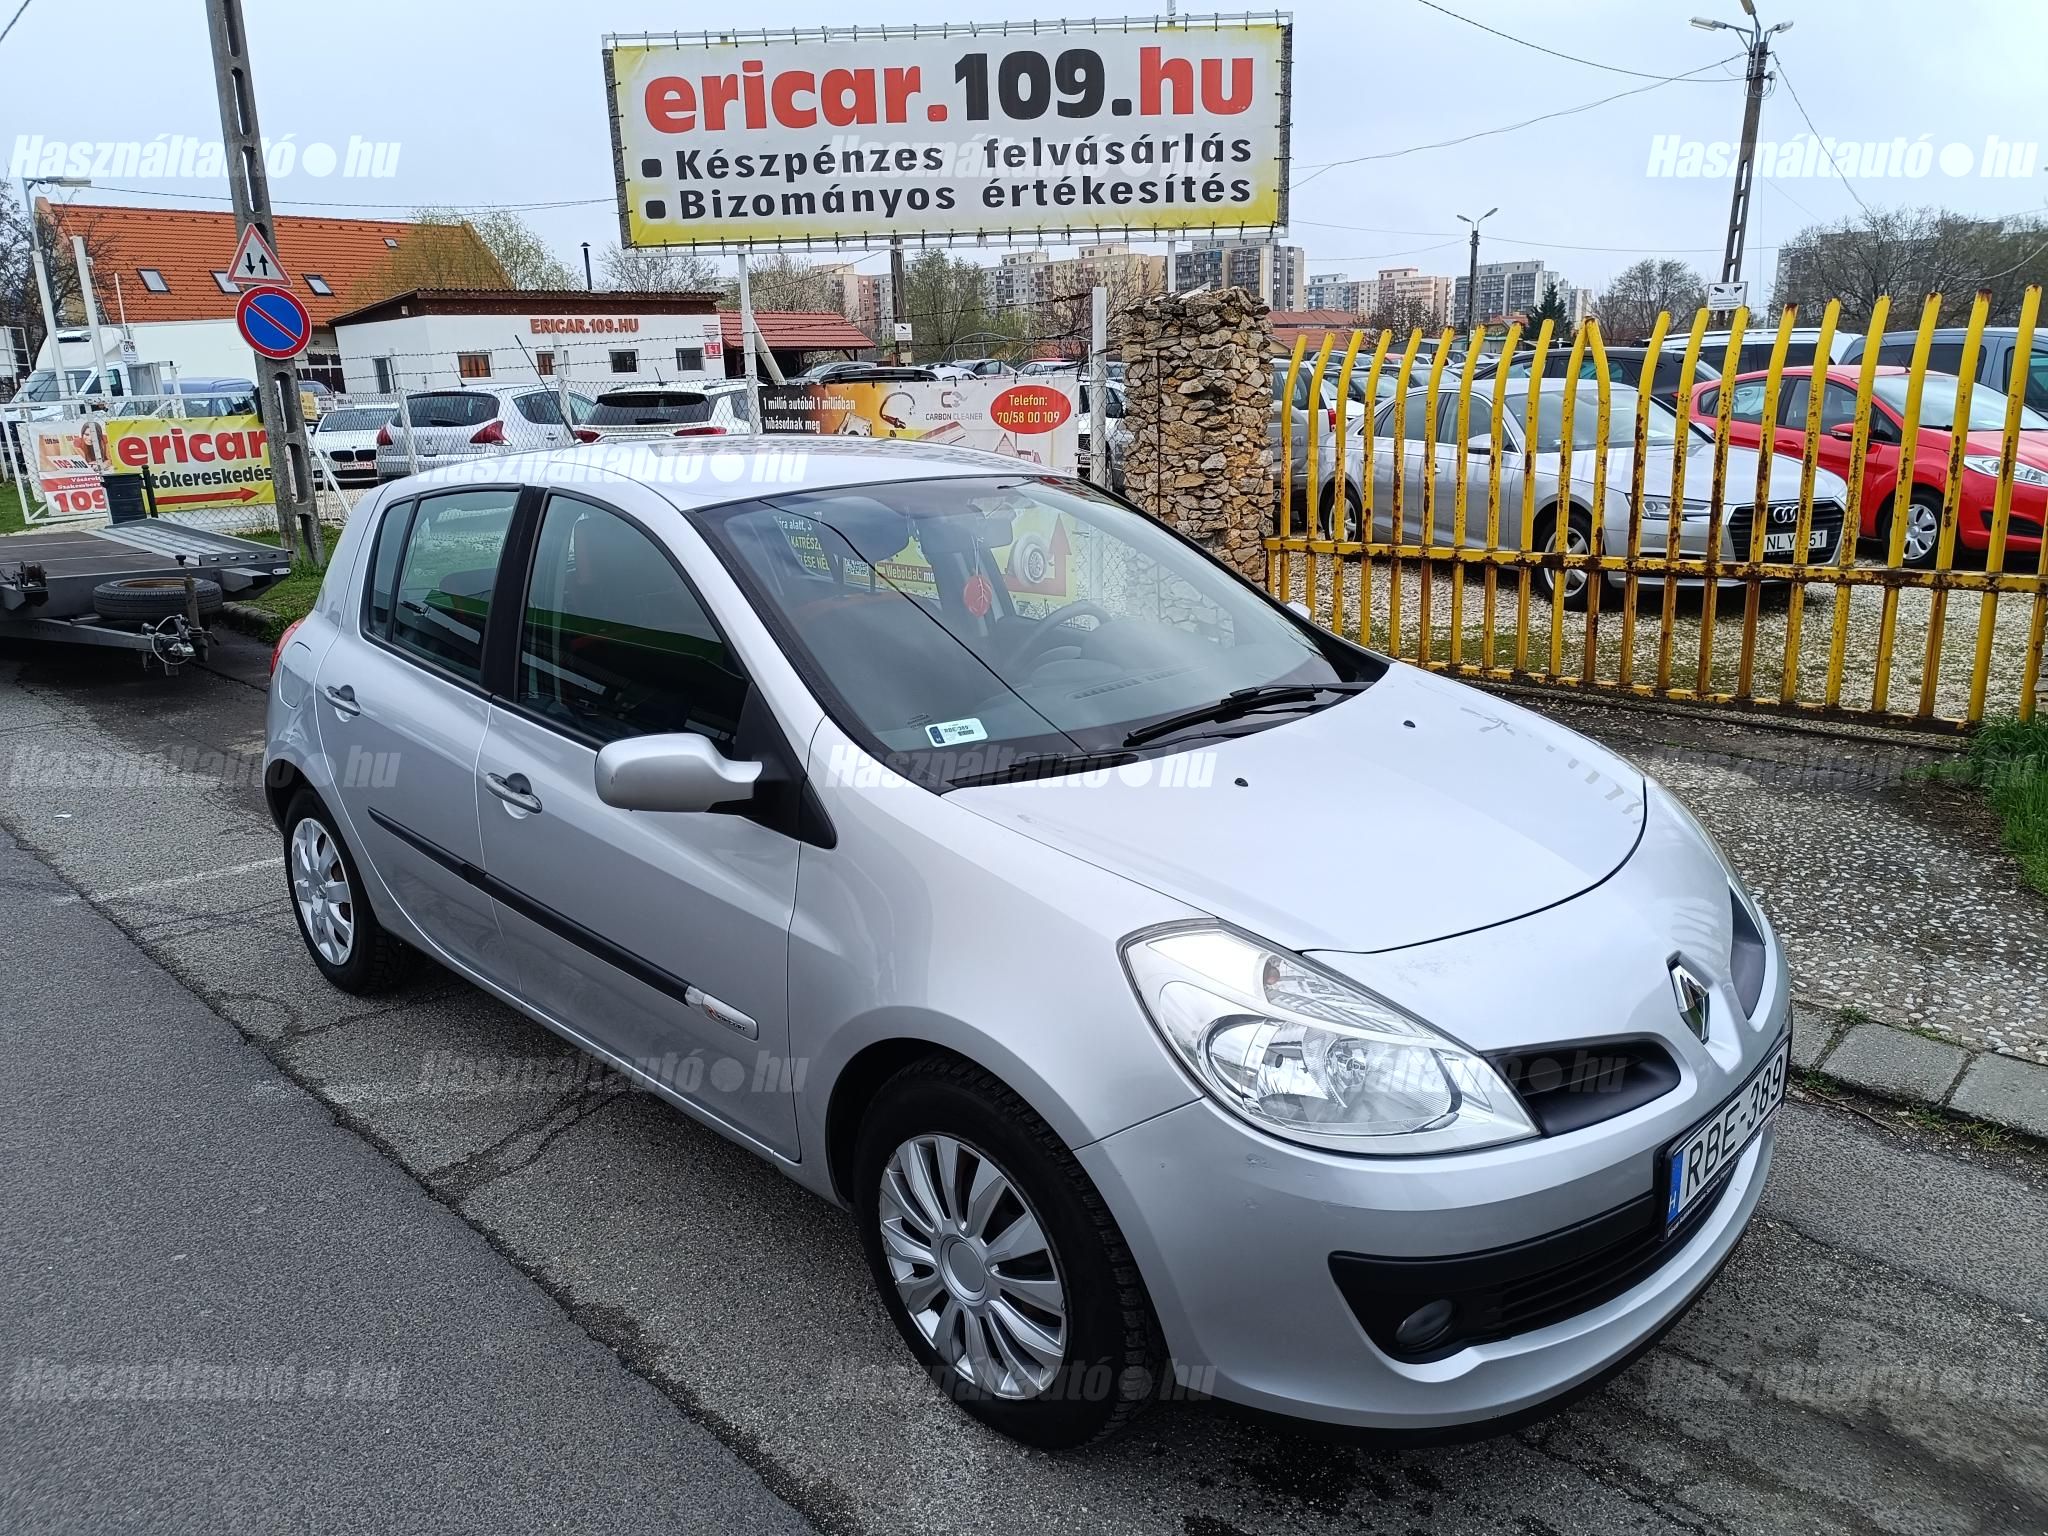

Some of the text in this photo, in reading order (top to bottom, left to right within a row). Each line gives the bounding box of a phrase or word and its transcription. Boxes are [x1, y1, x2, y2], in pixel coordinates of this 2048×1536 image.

[644, 46, 1254, 134] ericar.109.hu
[676, 134, 1252, 181] Készpénzes felvásárlás
[682, 174, 1252, 219] Bizományos értékesítés
[530, 318, 639, 334] ERICAR.109.HU
[769, 395, 787, 410] millió
[789, 395, 816, 410] autóból
[1009, 394, 1048, 406] Telefon:
[805, 420, 820, 433] meg
[925, 412, 983, 421] CARBON CLEANER
[998, 410, 1060, 424] 70/58 00 109
[118, 428, 268, 466] ericar
[53, 459, 88, 469] 109.hu
[141, 465, 272, 489] tókereskedés
[54, 489, 107, 513] 109
[1685, 1053, 1783, 1198] RBE-389
